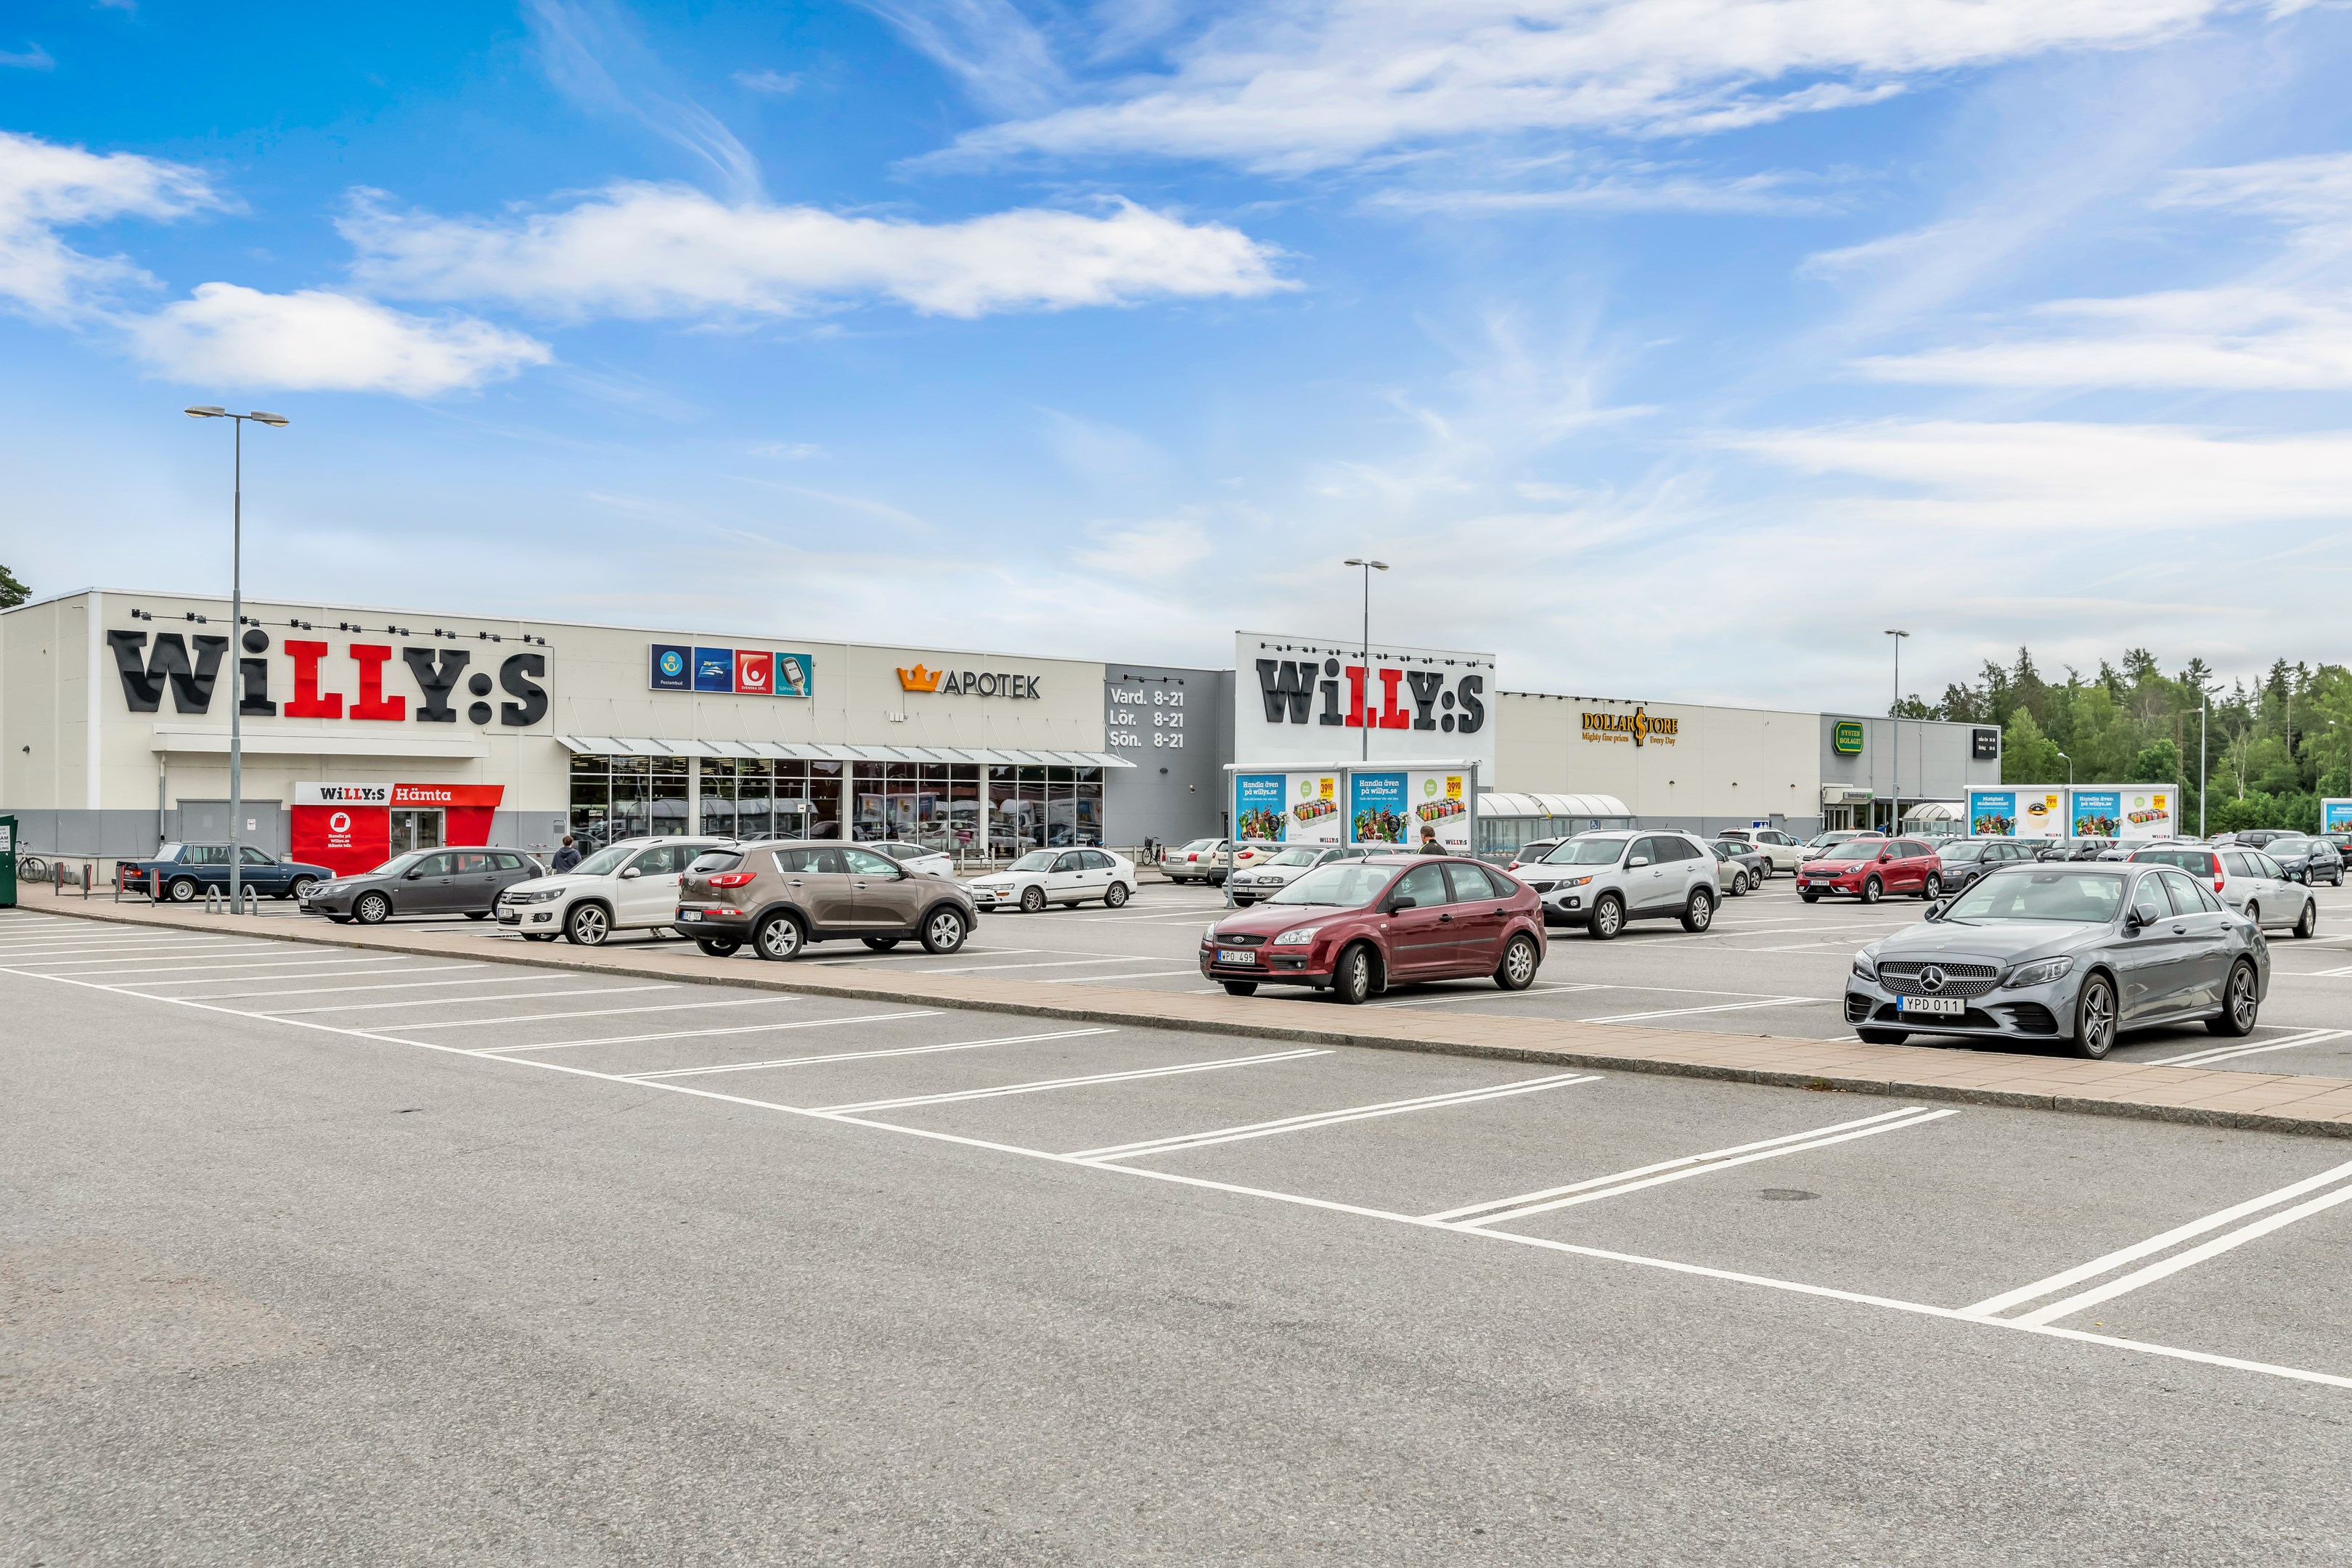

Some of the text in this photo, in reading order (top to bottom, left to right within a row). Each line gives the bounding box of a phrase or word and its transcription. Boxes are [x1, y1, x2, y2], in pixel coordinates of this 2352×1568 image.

[943, 670, 1041, 699] APOTEK
[1110, 687, 1184, 707] Vard. 8-21
[1109, 709, 1184, 727] Lör. 8-21
[1110, 730, 1184, 749] Sön. 8-21
[1582, 732, 1676, 746] Mighty fine prices Every Day
[396, 788, 452, 801] Hämta
[1244, 788, 1252, 796] på
[1361, 787, 1369, 795] på
[1222, 952, 1254, 962] WPO 495
[1907, 998, 1957, 1012] YPD 011
